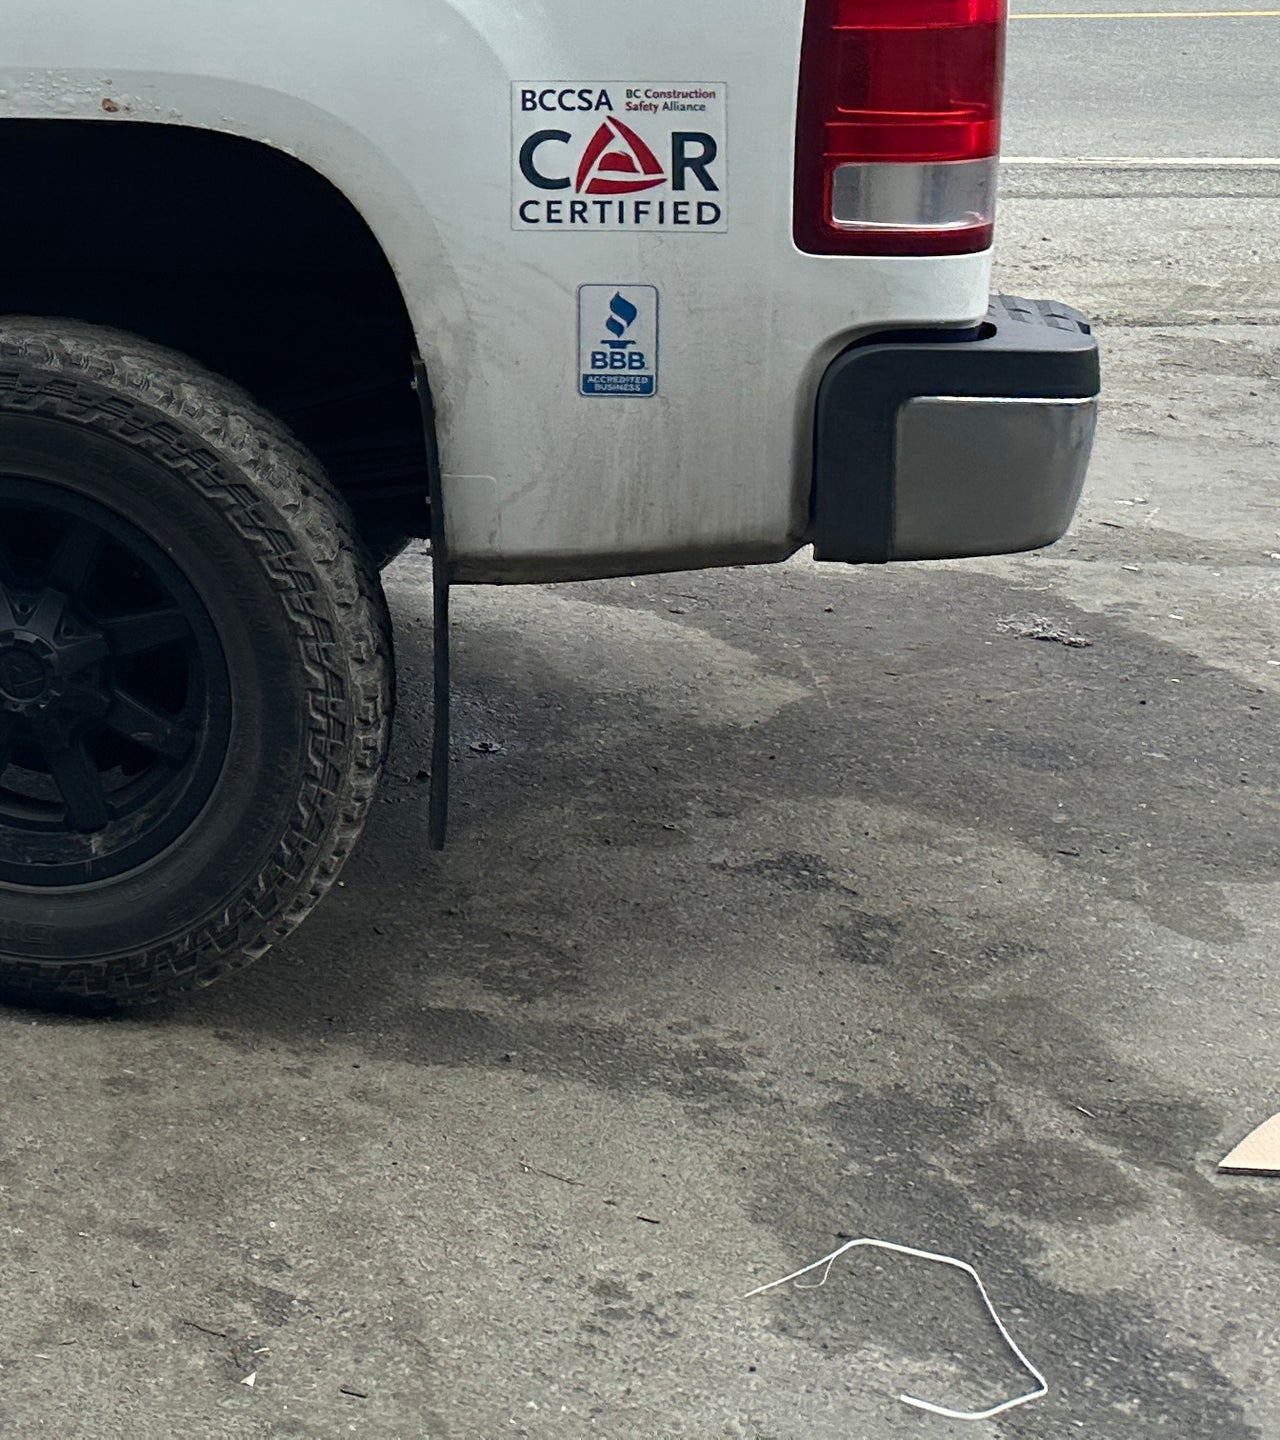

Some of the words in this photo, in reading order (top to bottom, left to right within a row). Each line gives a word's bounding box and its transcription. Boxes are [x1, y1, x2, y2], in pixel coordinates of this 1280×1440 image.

[521, 89, 614, 112] BCCSA
[625, 88, 642, 99] BC
[644, 87, 717, 100] Construction
[625, 101, 659, 115] Safety
[662, 101, 706, 112] Alliance
[519, 199, 722, 226] CERTIFIED
[590, 350, 646, 371] BBB
